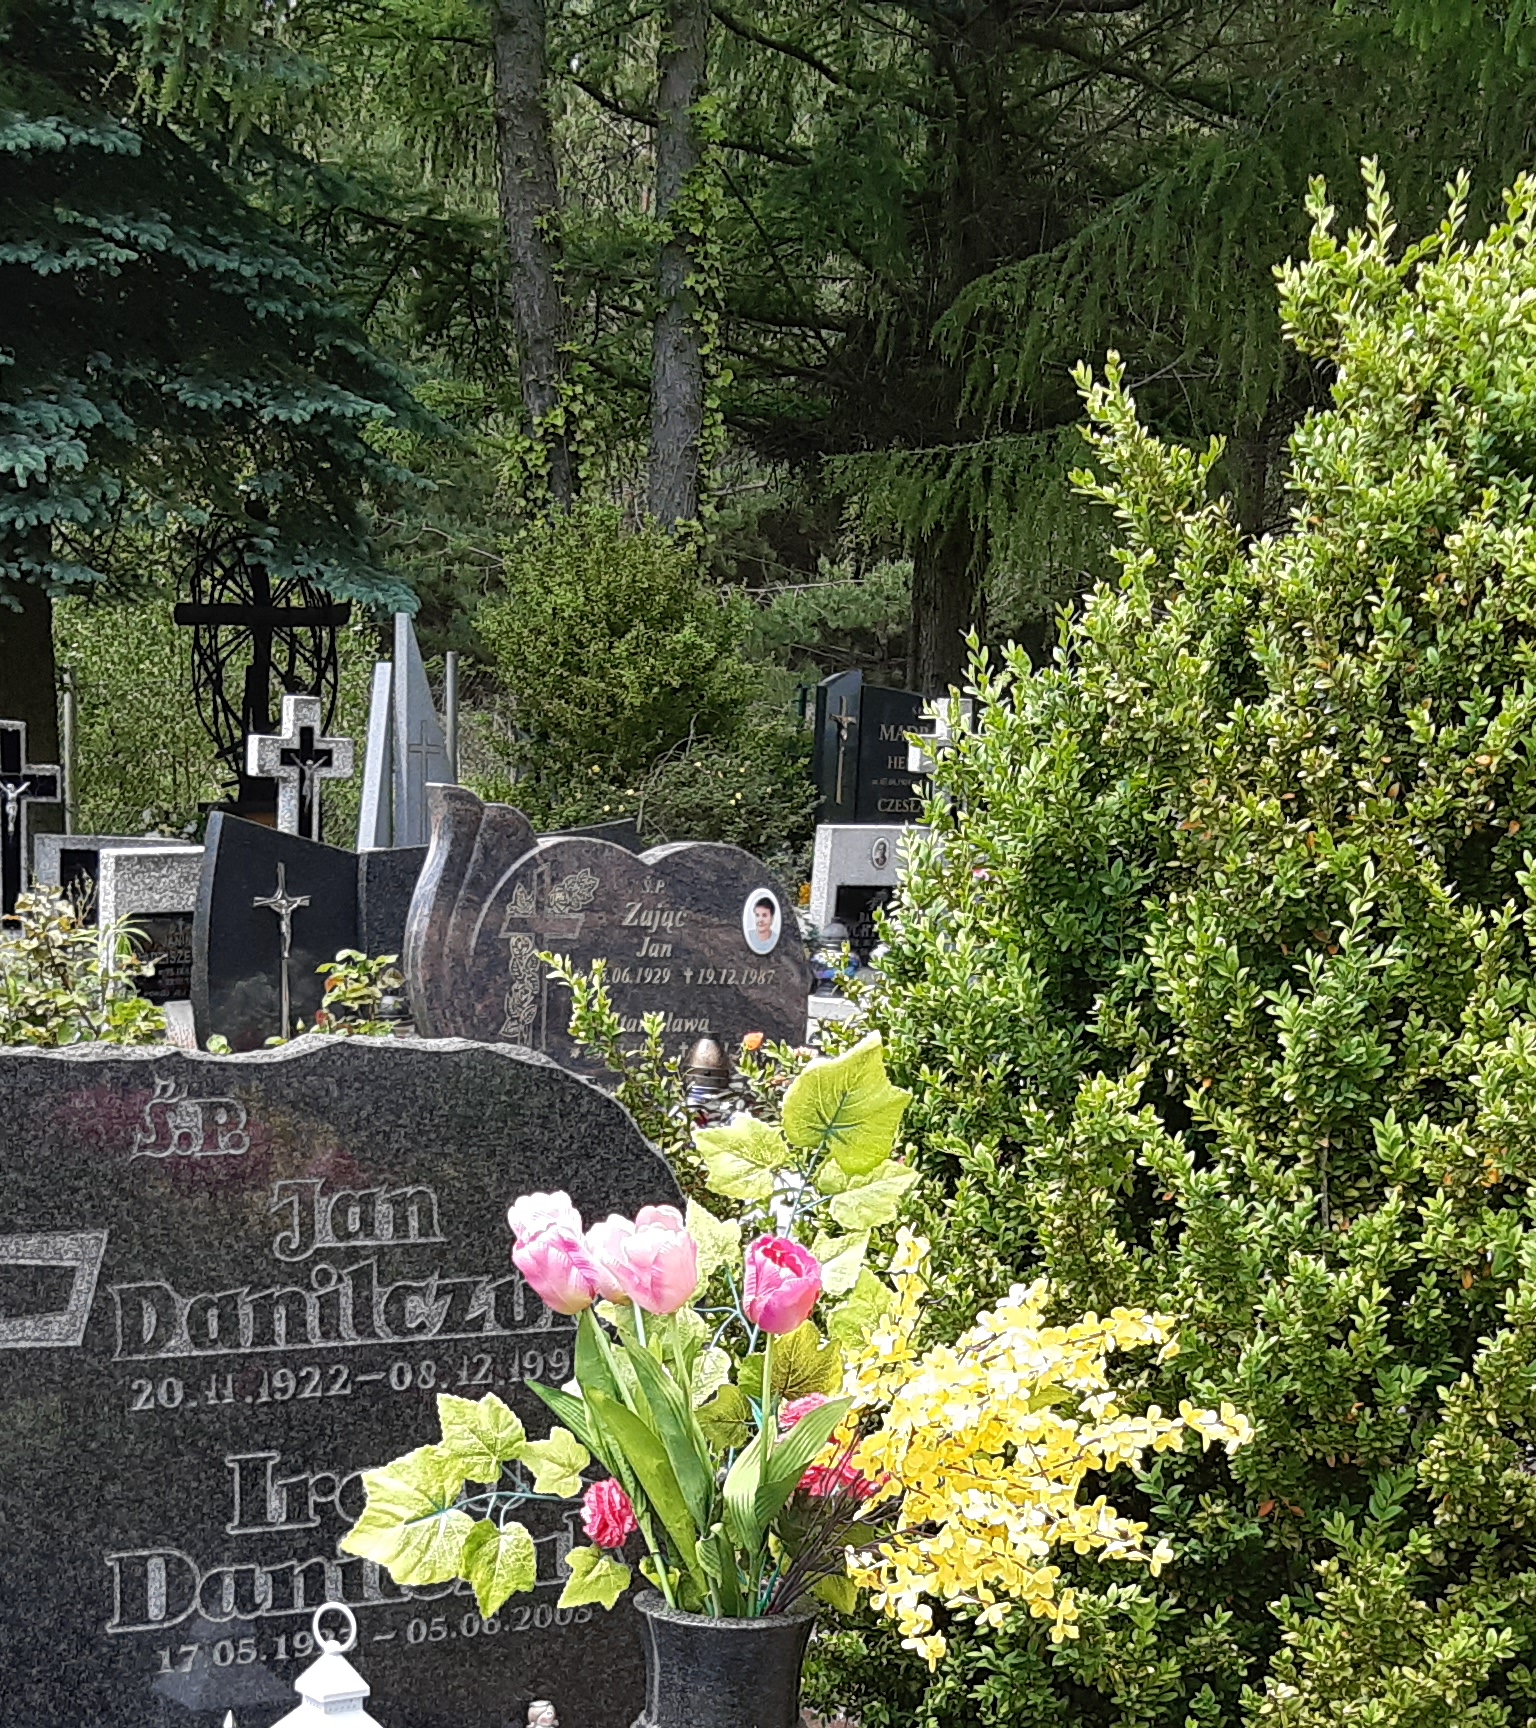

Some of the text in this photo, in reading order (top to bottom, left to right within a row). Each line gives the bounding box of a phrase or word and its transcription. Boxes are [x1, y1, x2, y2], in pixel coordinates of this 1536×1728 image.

[877, 798, 922, 813] CZESŁ
[621, 902, 687, 934] Zając
[636, 936, 672, 958] Jan
[697, 969, 776, 985] 19.12.1987
[270, 1177, 448, 1262] Jan
[107, 1256, 580, 1363] Danilczu
